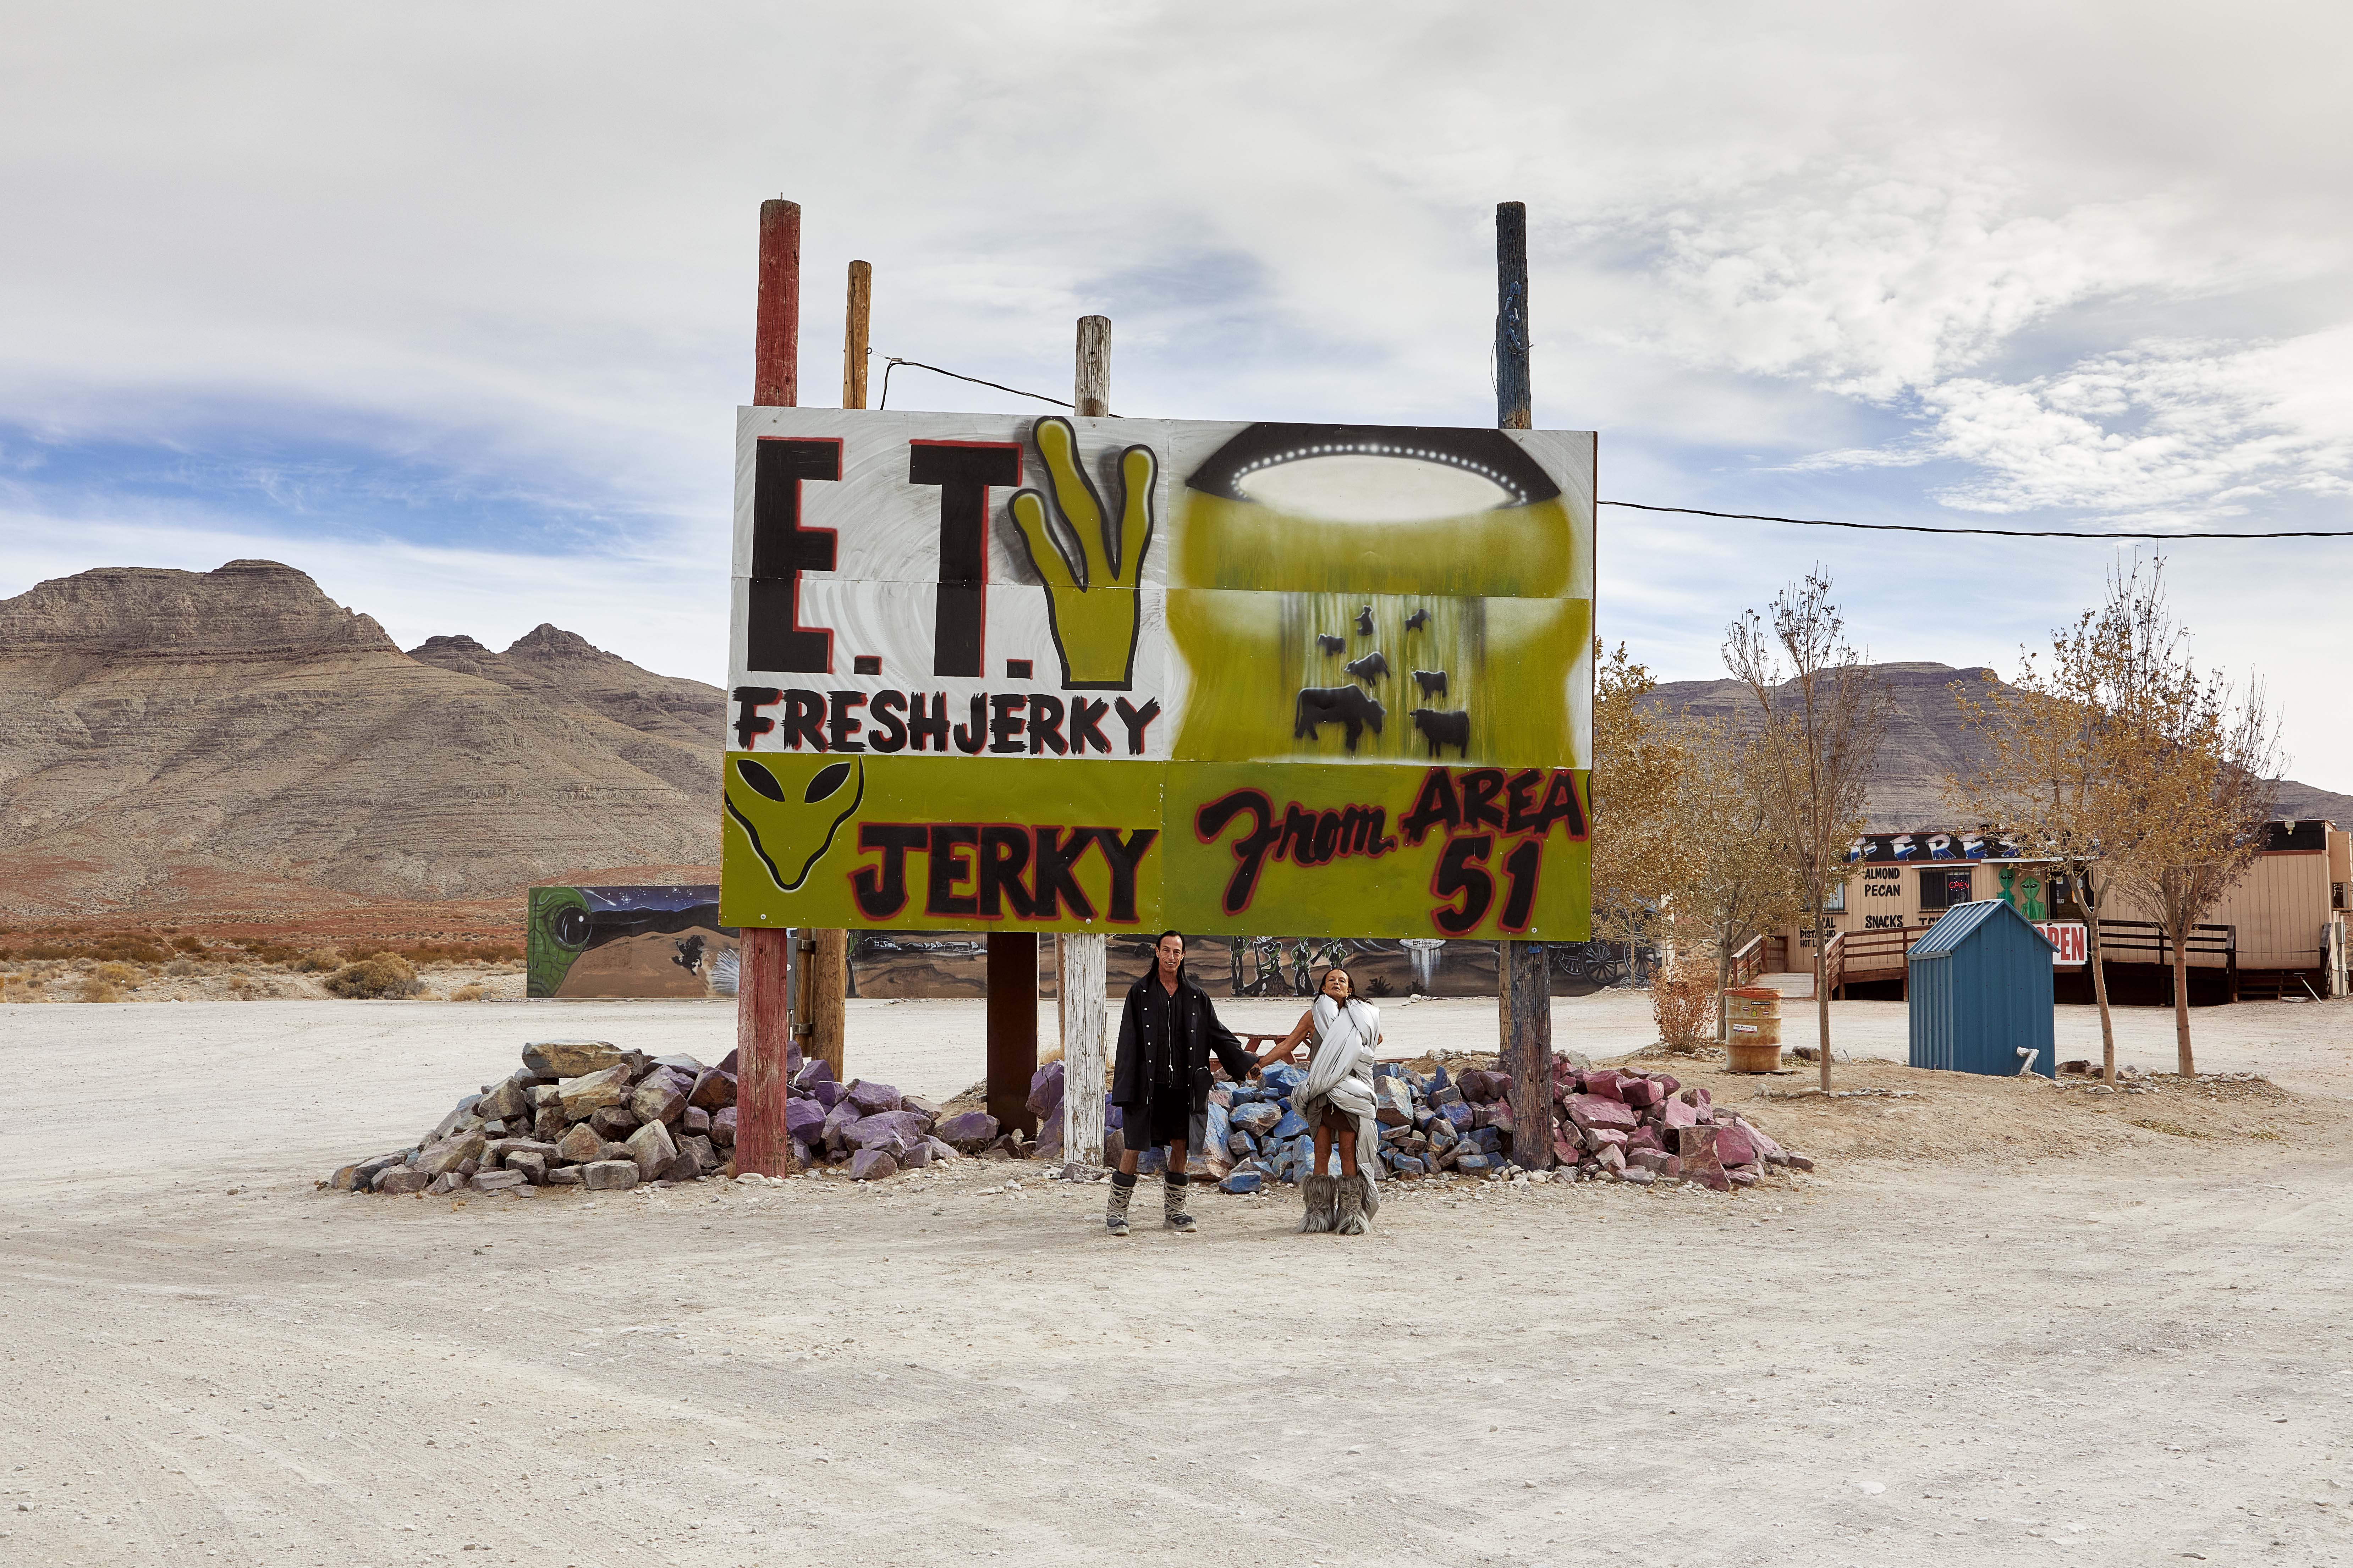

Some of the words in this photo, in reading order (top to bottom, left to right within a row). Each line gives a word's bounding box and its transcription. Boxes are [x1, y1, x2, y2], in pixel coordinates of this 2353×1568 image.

[747, 436, 1033, 679] E.T.
[1400, 767, 1589, 846] AREA
[847, 821, 1161, 923] JERKY
[1430, 834, 1543, 937] 51
[1865, 868, 1900, 879] ALMOND
[1865, 884, 1900, 897] PECAN
[1800, 939, 1811, 948] HOT
[1865, 915, 1903, 928] SNACKS
